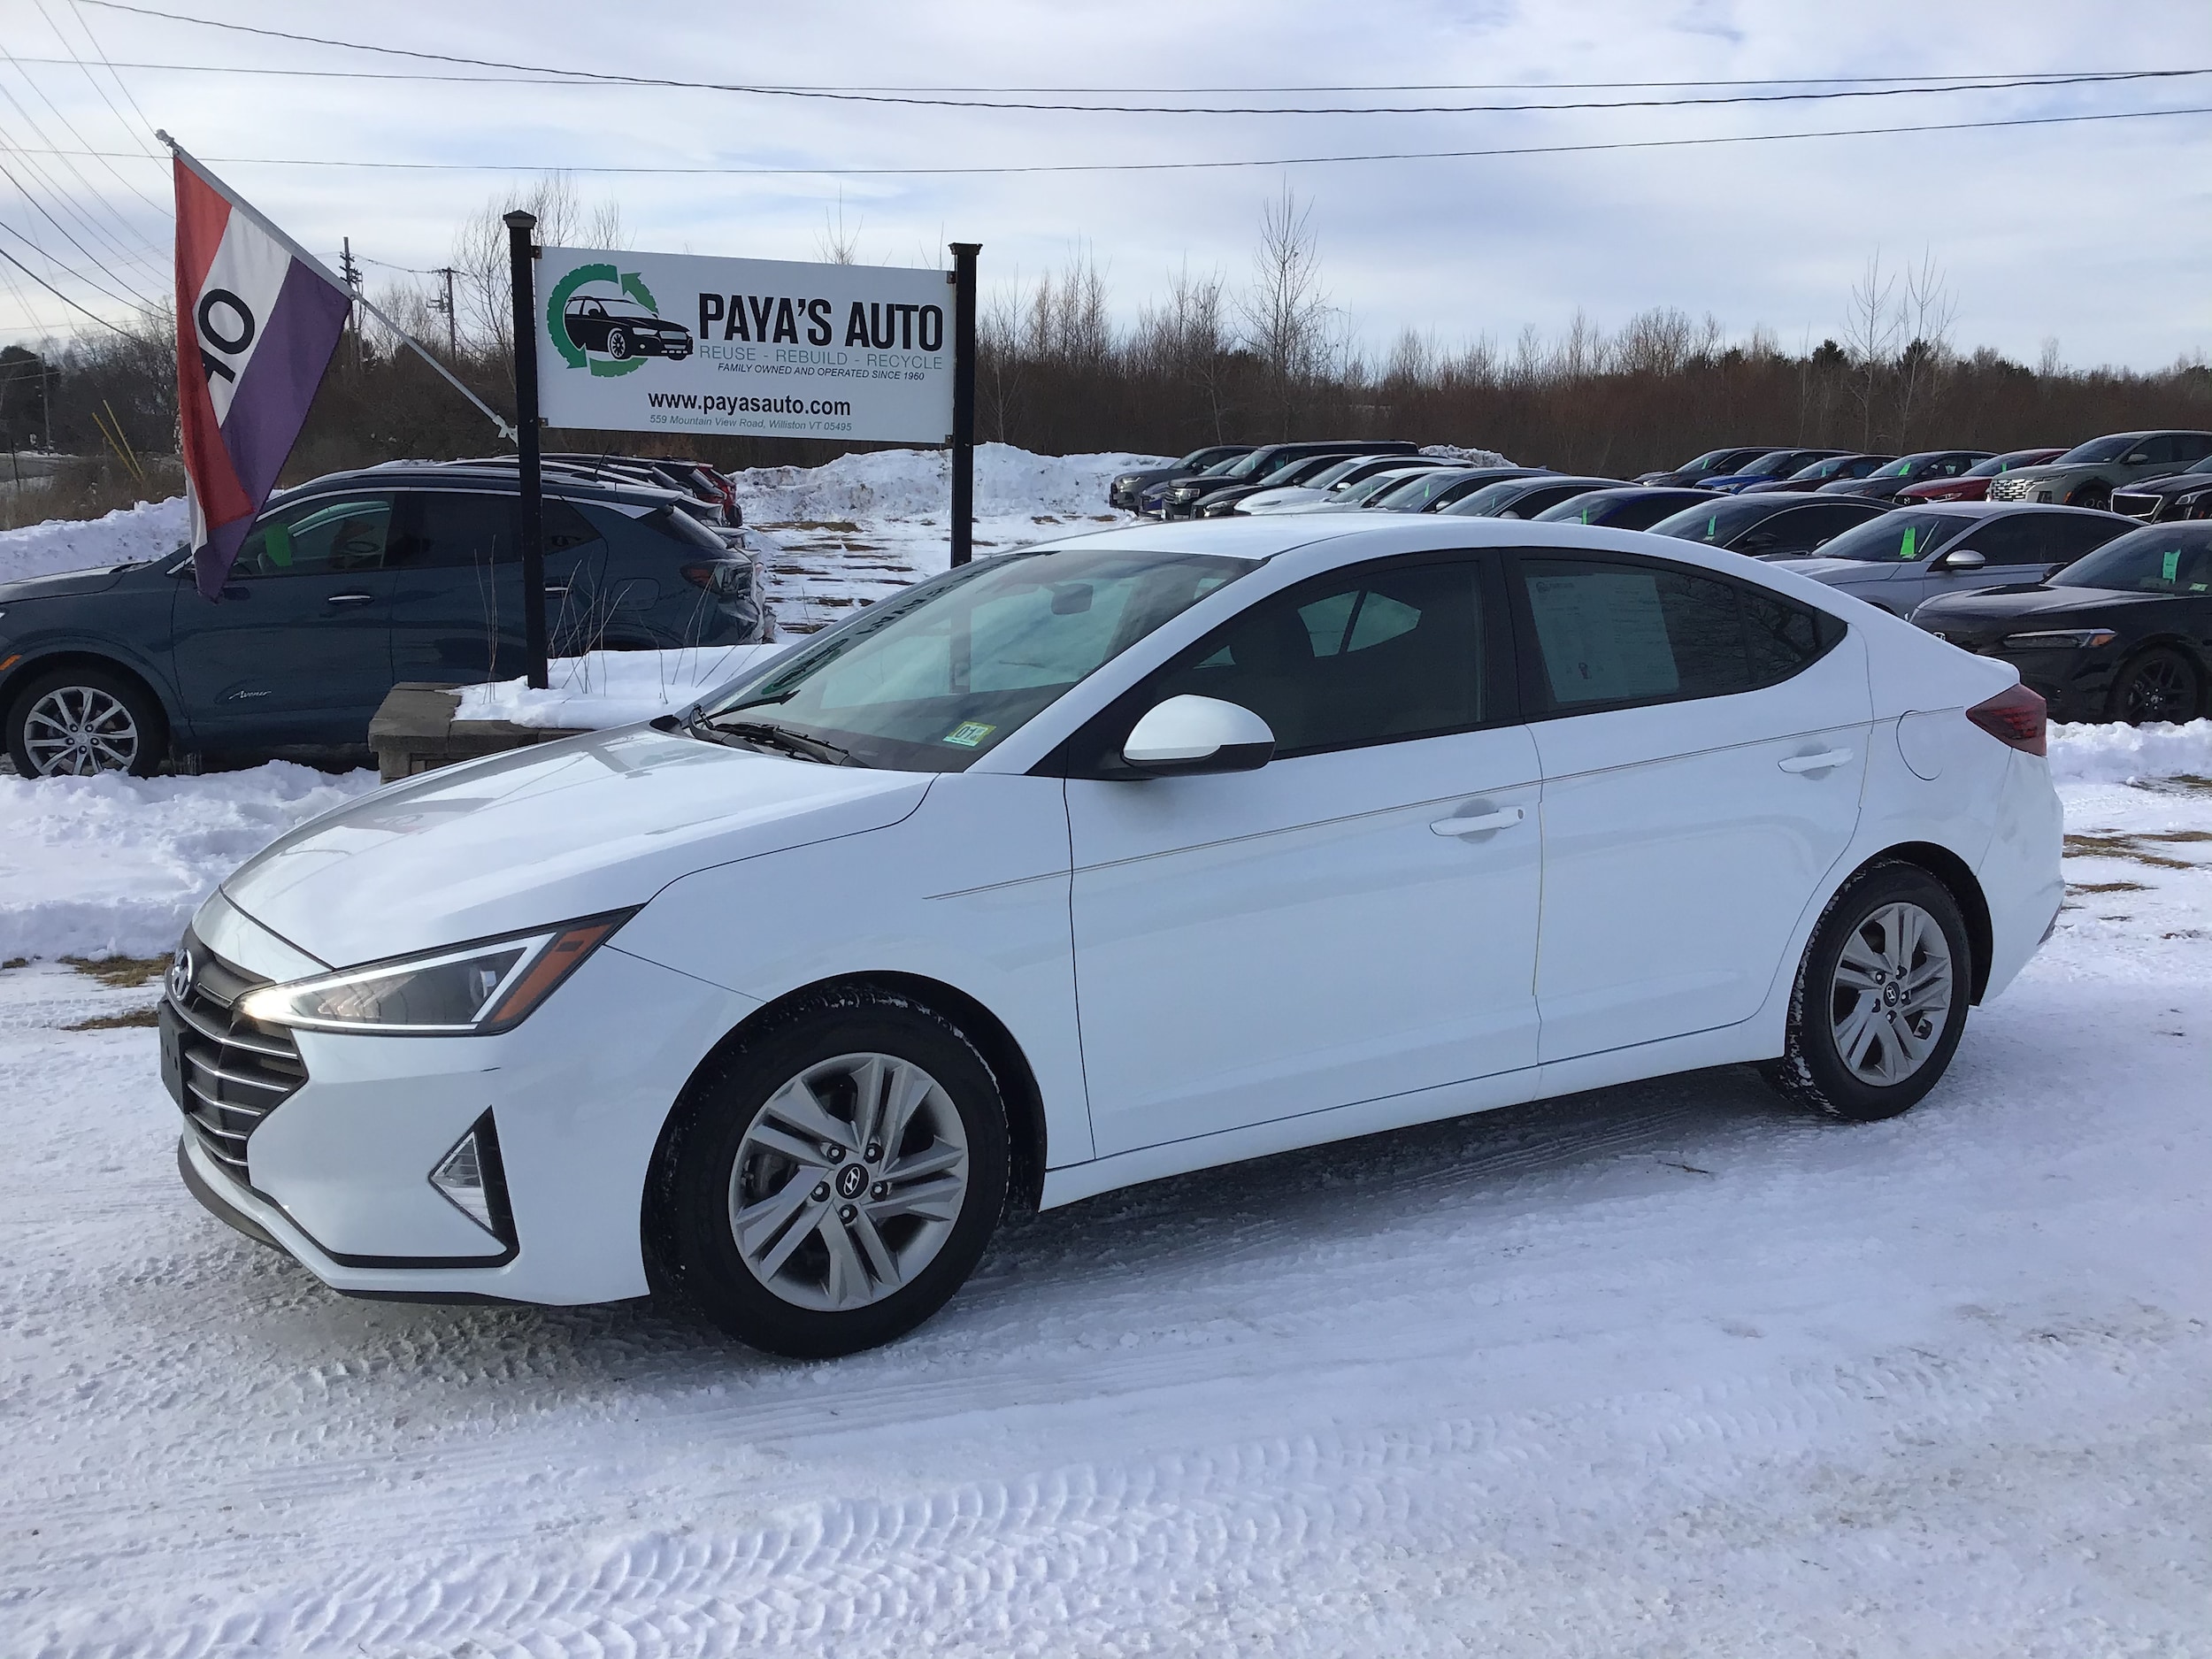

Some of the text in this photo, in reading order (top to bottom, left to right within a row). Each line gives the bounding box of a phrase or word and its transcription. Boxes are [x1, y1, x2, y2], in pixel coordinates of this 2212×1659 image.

[699, 293, 943, 351] PAYA'S AUTO
[700, 345, 757, 361] REUSE
[776, 349, 848, 365] REBUILD
[867, 353, 942, 369] RECYCLE
[718, 363, 925, 380] FAMILY OWNED AND OPERATED SINCE 1960
[648, 393, 850, 416] www.payasauto.com
[649, 414, 852, 431] 559 Mountain View Road, Williston VT 05495
